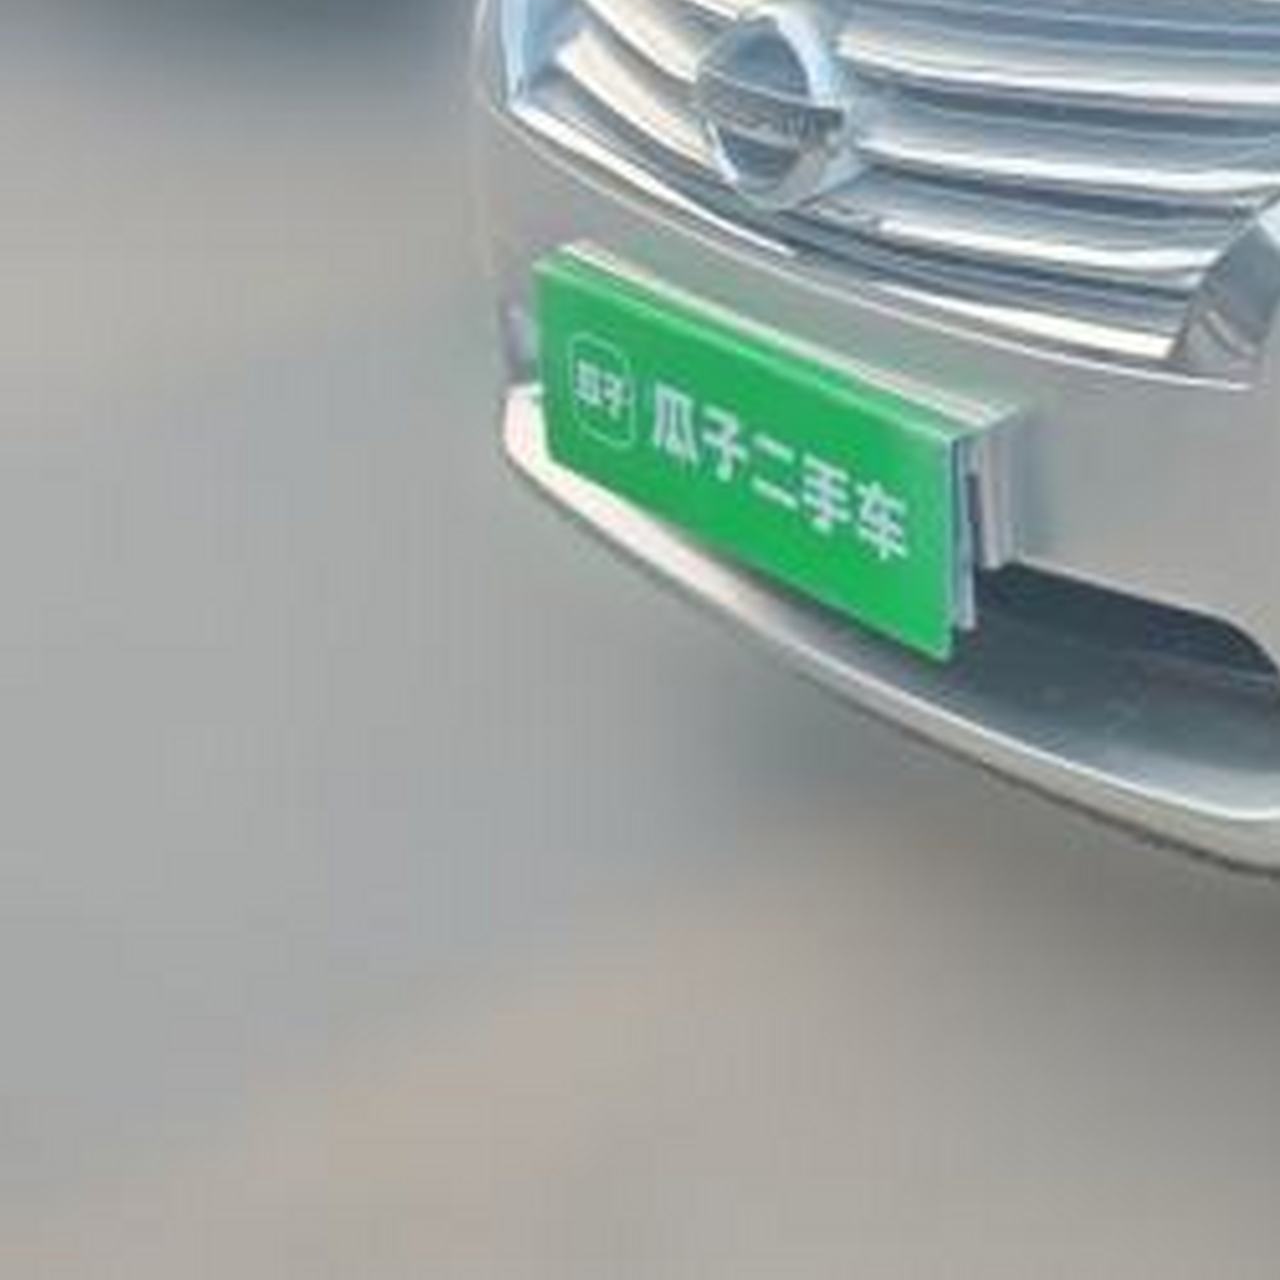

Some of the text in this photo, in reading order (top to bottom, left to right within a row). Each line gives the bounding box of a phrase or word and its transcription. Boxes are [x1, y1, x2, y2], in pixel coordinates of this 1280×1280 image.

[652, 381, 909, 561] 瓜子二手车
